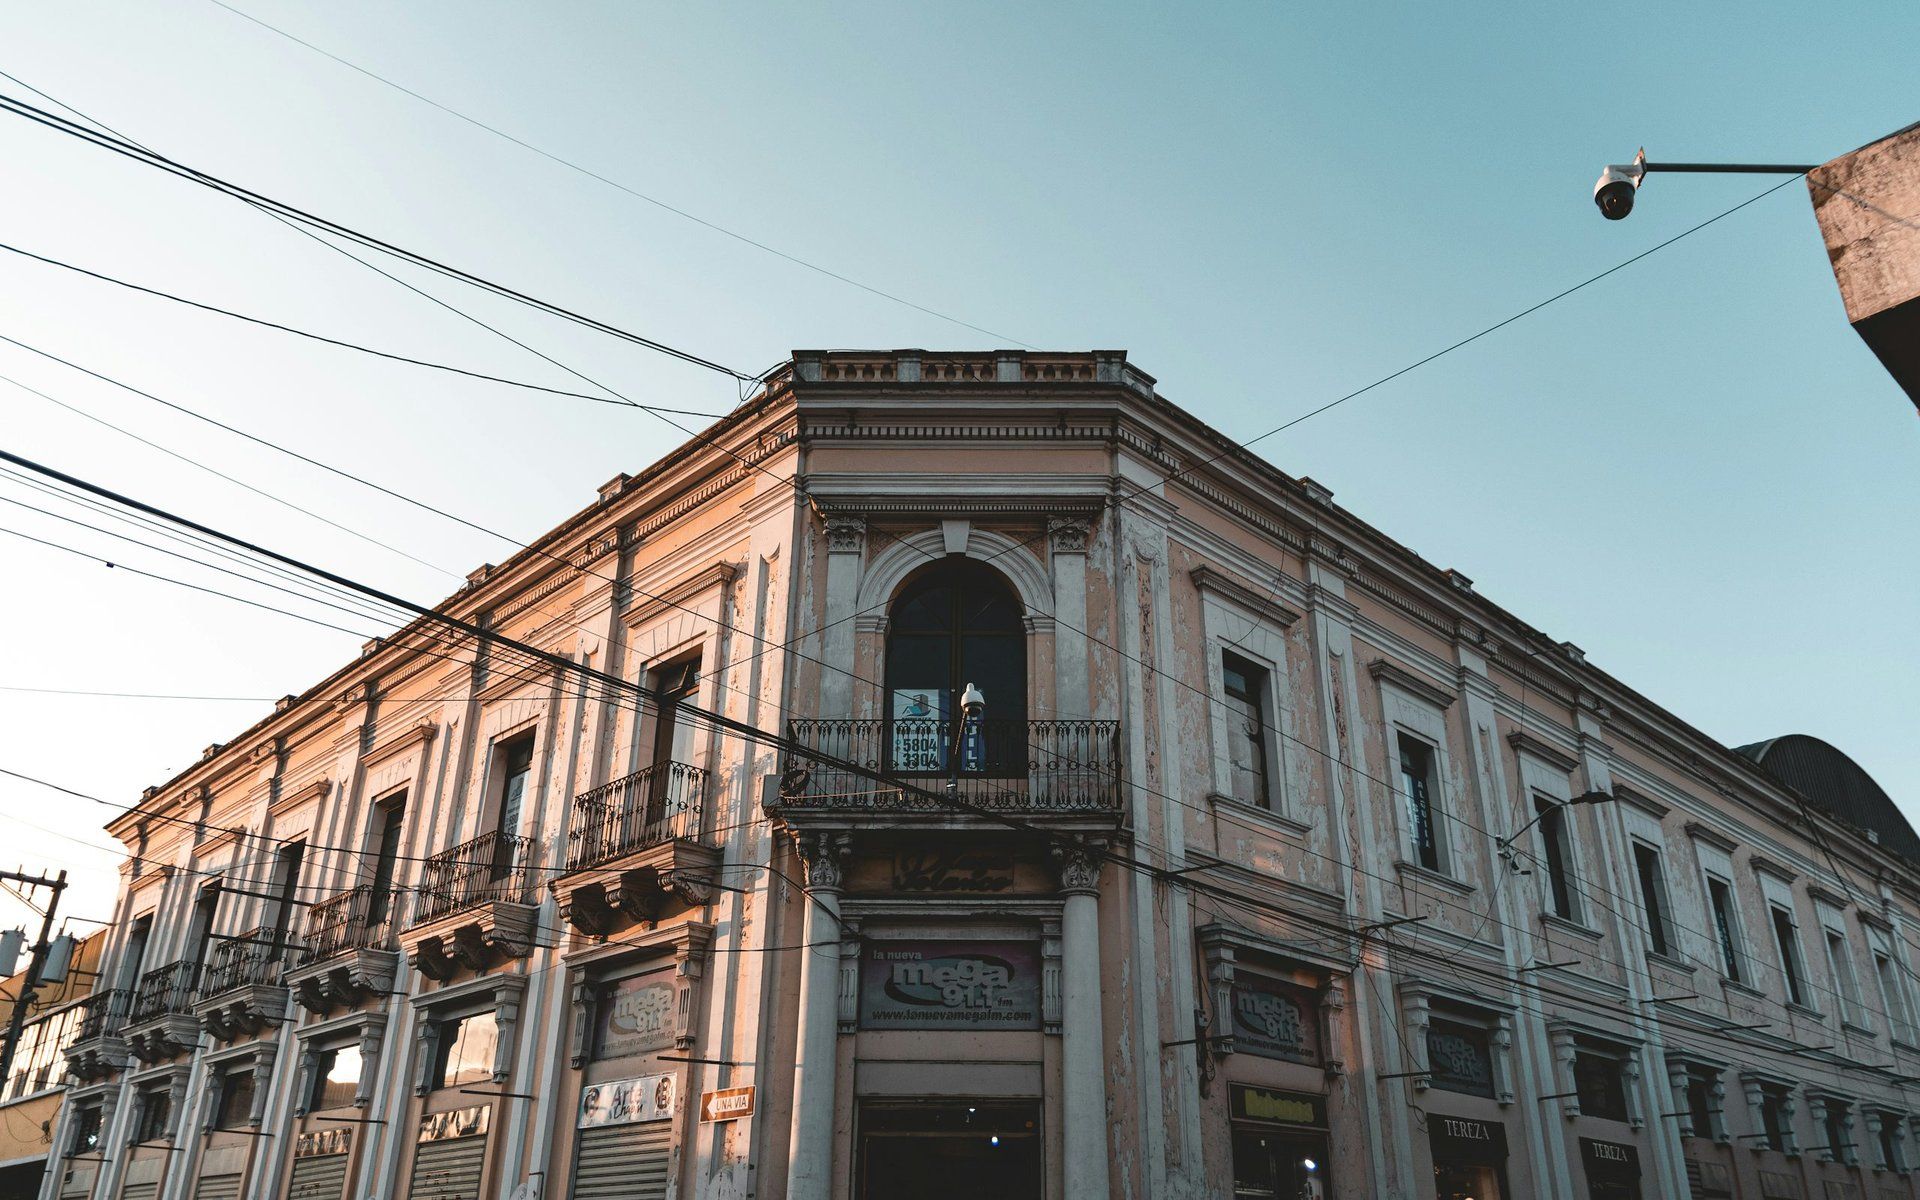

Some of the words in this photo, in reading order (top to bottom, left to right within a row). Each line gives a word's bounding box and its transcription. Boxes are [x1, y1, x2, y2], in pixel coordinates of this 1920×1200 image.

[903, 739, 937, 752] 5804
[886, 951, 923, 960] nueva
[893, 959, 1009, 989] mega
[614, 987, 673, 1018] mega
[1237, 991, 1300, 1027] mega
[716, 1098, 732, 1111] UNA
[734, 1095, 747, 1109] VIA
[1444, 1119, 1490, 1140] TEREZA
[1592, 1142, 1629, 1162] TEREZA
